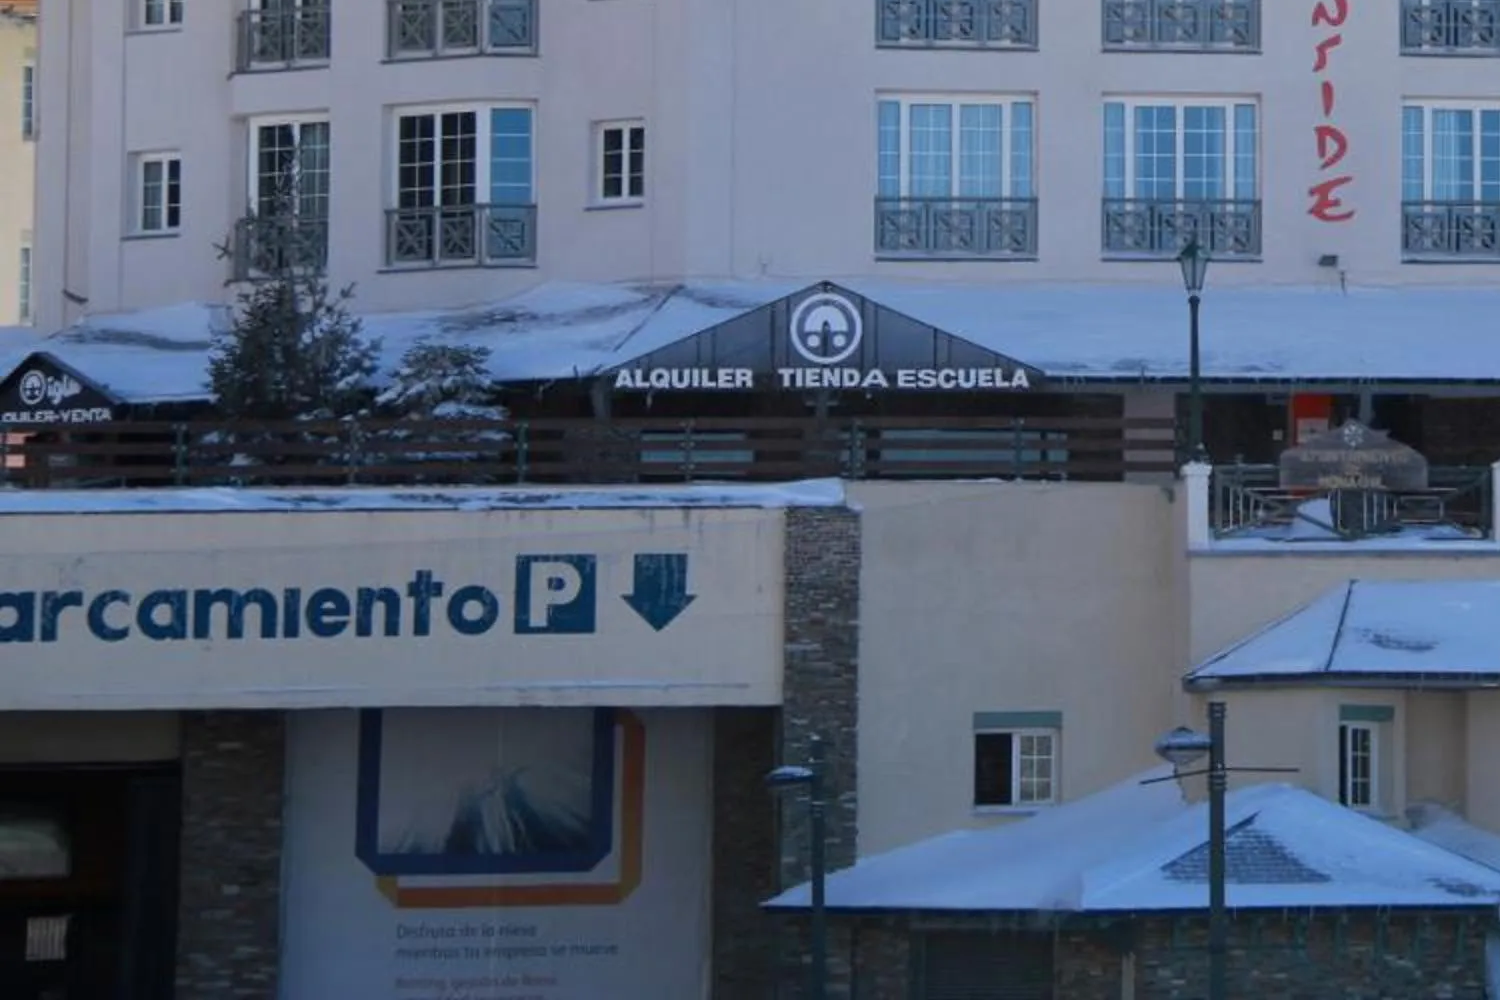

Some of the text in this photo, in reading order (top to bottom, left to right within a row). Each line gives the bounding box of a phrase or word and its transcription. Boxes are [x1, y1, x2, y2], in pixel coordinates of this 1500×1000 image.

[615, 368, 1030, 389] ALQUILER TIENDA ESCUELA
[528, 560, 582, 628] P
